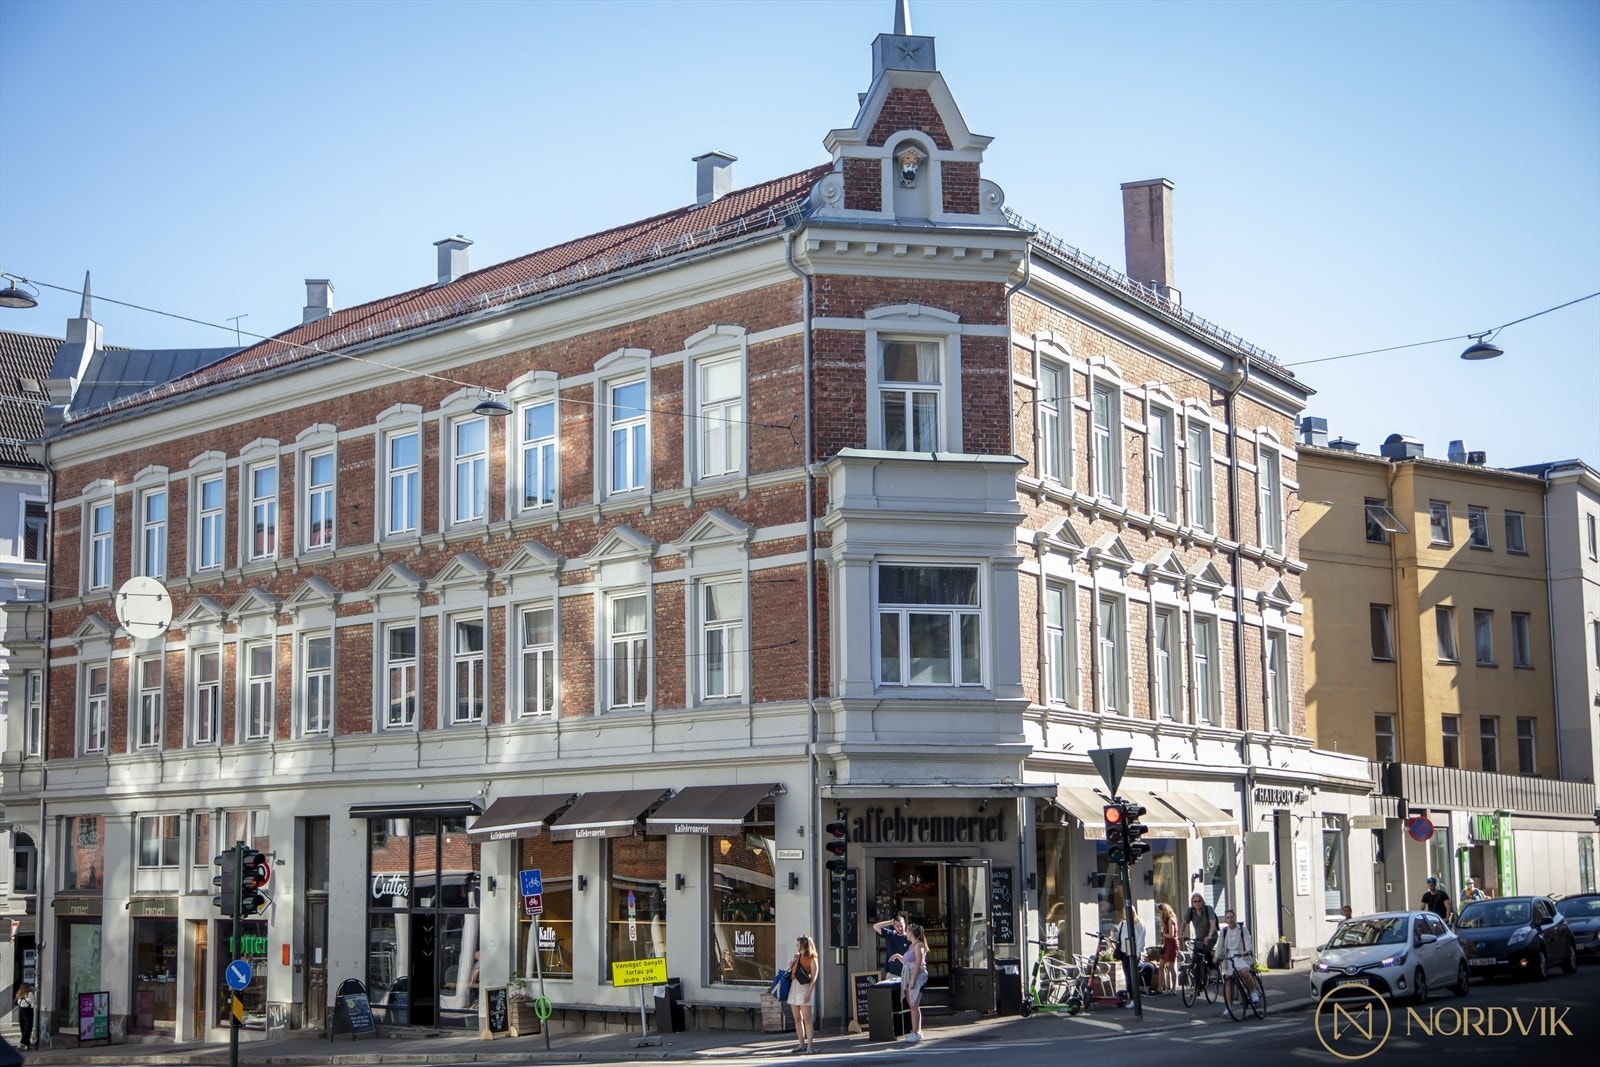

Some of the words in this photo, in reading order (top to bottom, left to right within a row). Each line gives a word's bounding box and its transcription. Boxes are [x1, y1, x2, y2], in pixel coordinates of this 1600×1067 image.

[373, 873, 410, 899] Cutter
[539, 926, 555, 940] Kaffe
[735, 930, 755, 945] Kaffe
[615, 961, 642, 969] Vennligst
[644, 959, 663, 967] benytt
